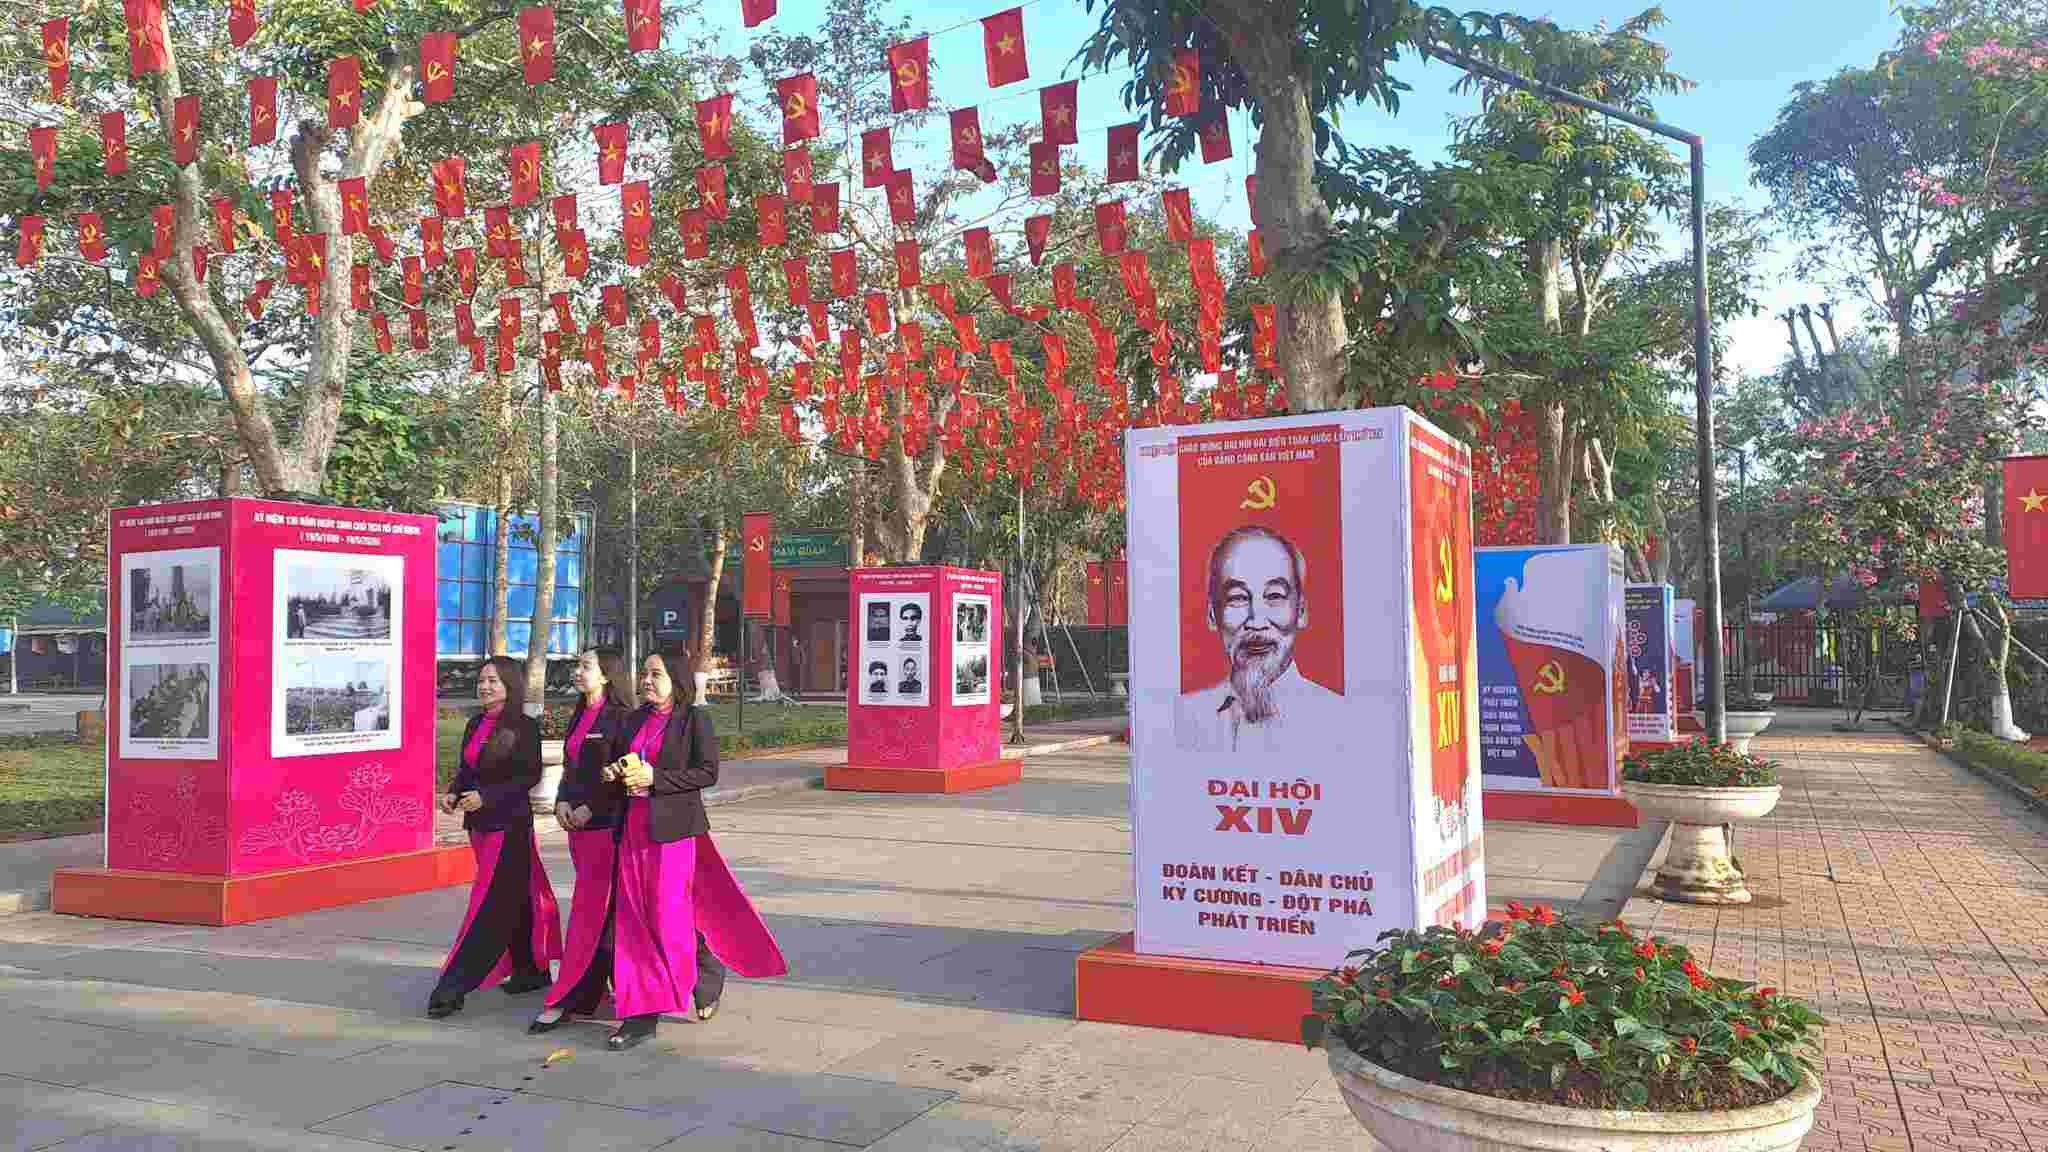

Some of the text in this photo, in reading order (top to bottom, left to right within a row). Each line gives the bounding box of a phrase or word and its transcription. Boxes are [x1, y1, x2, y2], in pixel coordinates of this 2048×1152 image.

[664, 611, 677, 626] P
[1207, 778, 1321, 805] ĐẠI HỘI
[1215, 805, 1313, 835] XIV
[1162, 858, 1216, 881] ĐOÀN
[1222, 862, 1259, 884] KẾT
[1280, 866, 1323, 889] DÂN
[1330, 870, 1374, 892] CHỦ
[1162, 882, 1187, 901] KỶ
[1193, 887, 1262, 907] CƯƠNG
[1282, 892, 1323, 917] ĐỘT
[1329, 896, 1373, 917] PHÁ
[1198, 909, 1316, 935] PHÁT TRIỂN
